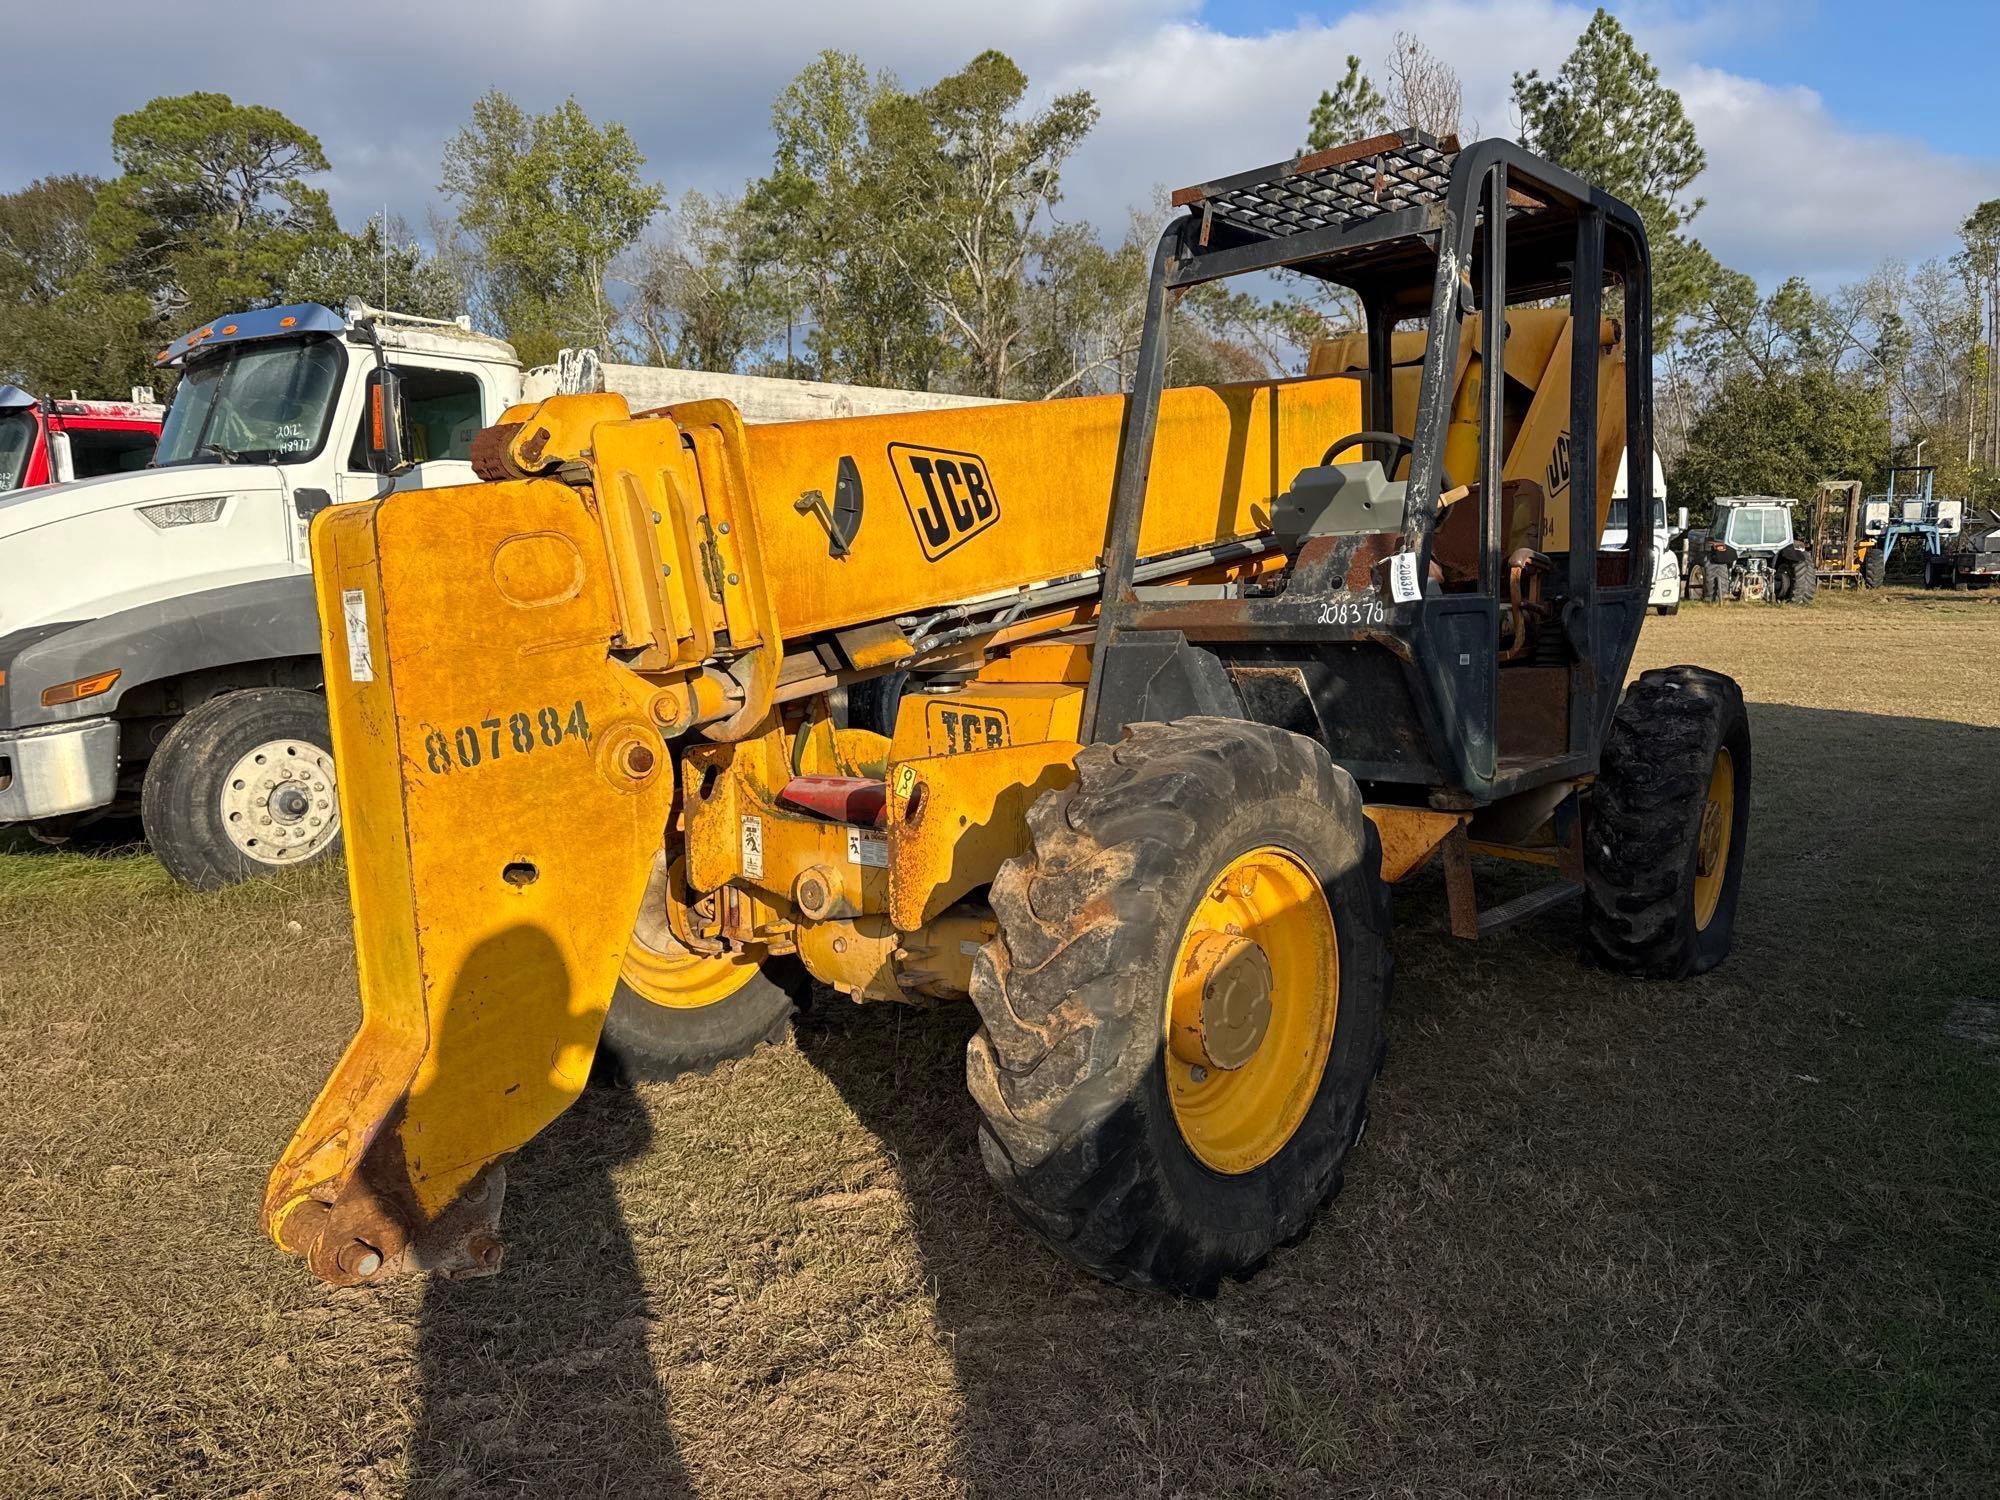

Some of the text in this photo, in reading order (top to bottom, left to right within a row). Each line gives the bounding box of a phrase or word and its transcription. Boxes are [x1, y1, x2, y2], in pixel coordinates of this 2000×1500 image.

[1549, 436, 1571, 489] JC
[908, 455, 993, 547] JCB
[1400, 563, 1415, 597] 208378
[1317, 600, 1384, 624] 208378
[425, 700, 592, 775] 807884
